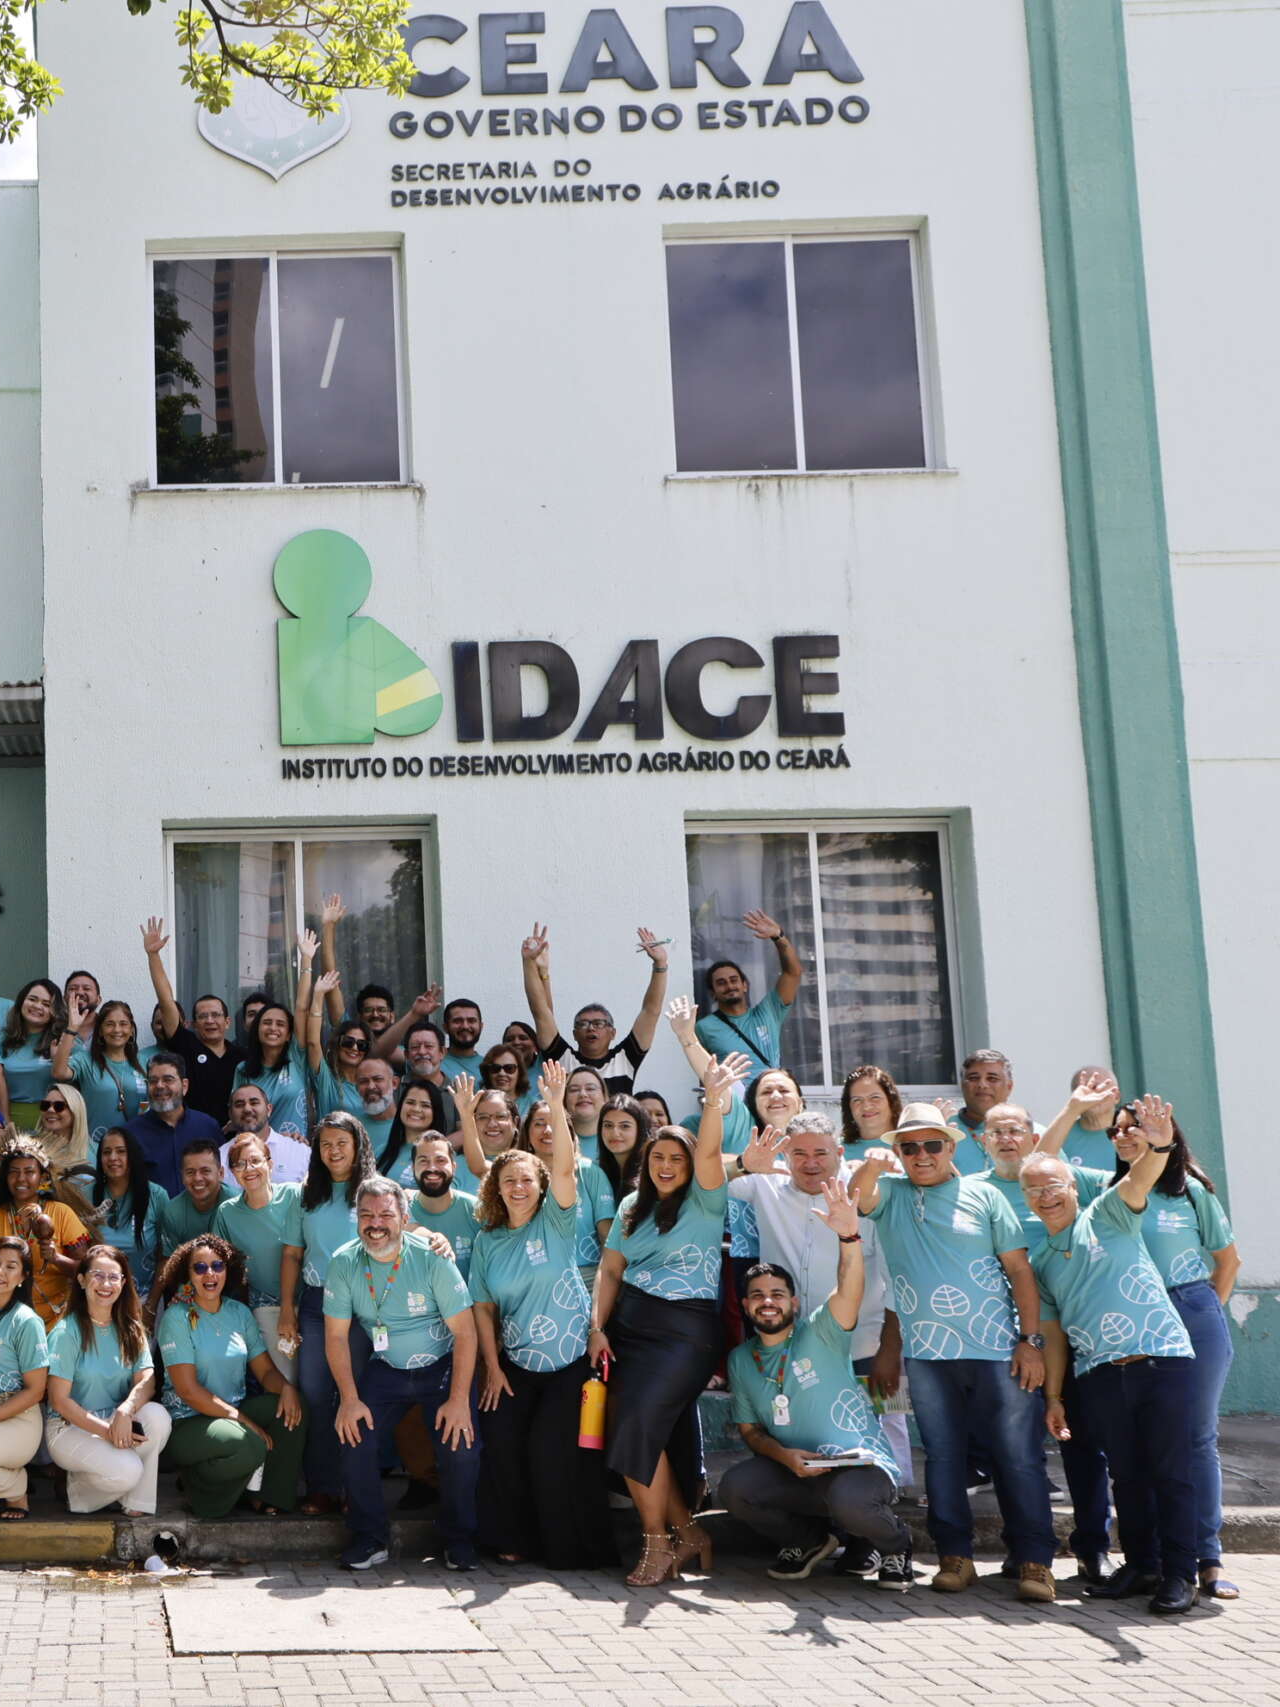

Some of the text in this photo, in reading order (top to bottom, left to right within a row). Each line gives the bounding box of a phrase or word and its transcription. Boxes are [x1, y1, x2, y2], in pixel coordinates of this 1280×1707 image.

[389, 95, 870, 139] GOVERNO DO ESTADO
[391, 158, 592, 182] SECRETARIA DO
[391, 174, 780, 208] DESENVOLVIMENTO AGRÁRIO
[451, 635, 846, 742] IDACE
[281, 744, 851, 779] INSTITUTO DO DESENVOLVIMENTO AGRÁRIO DO CEARÁ
